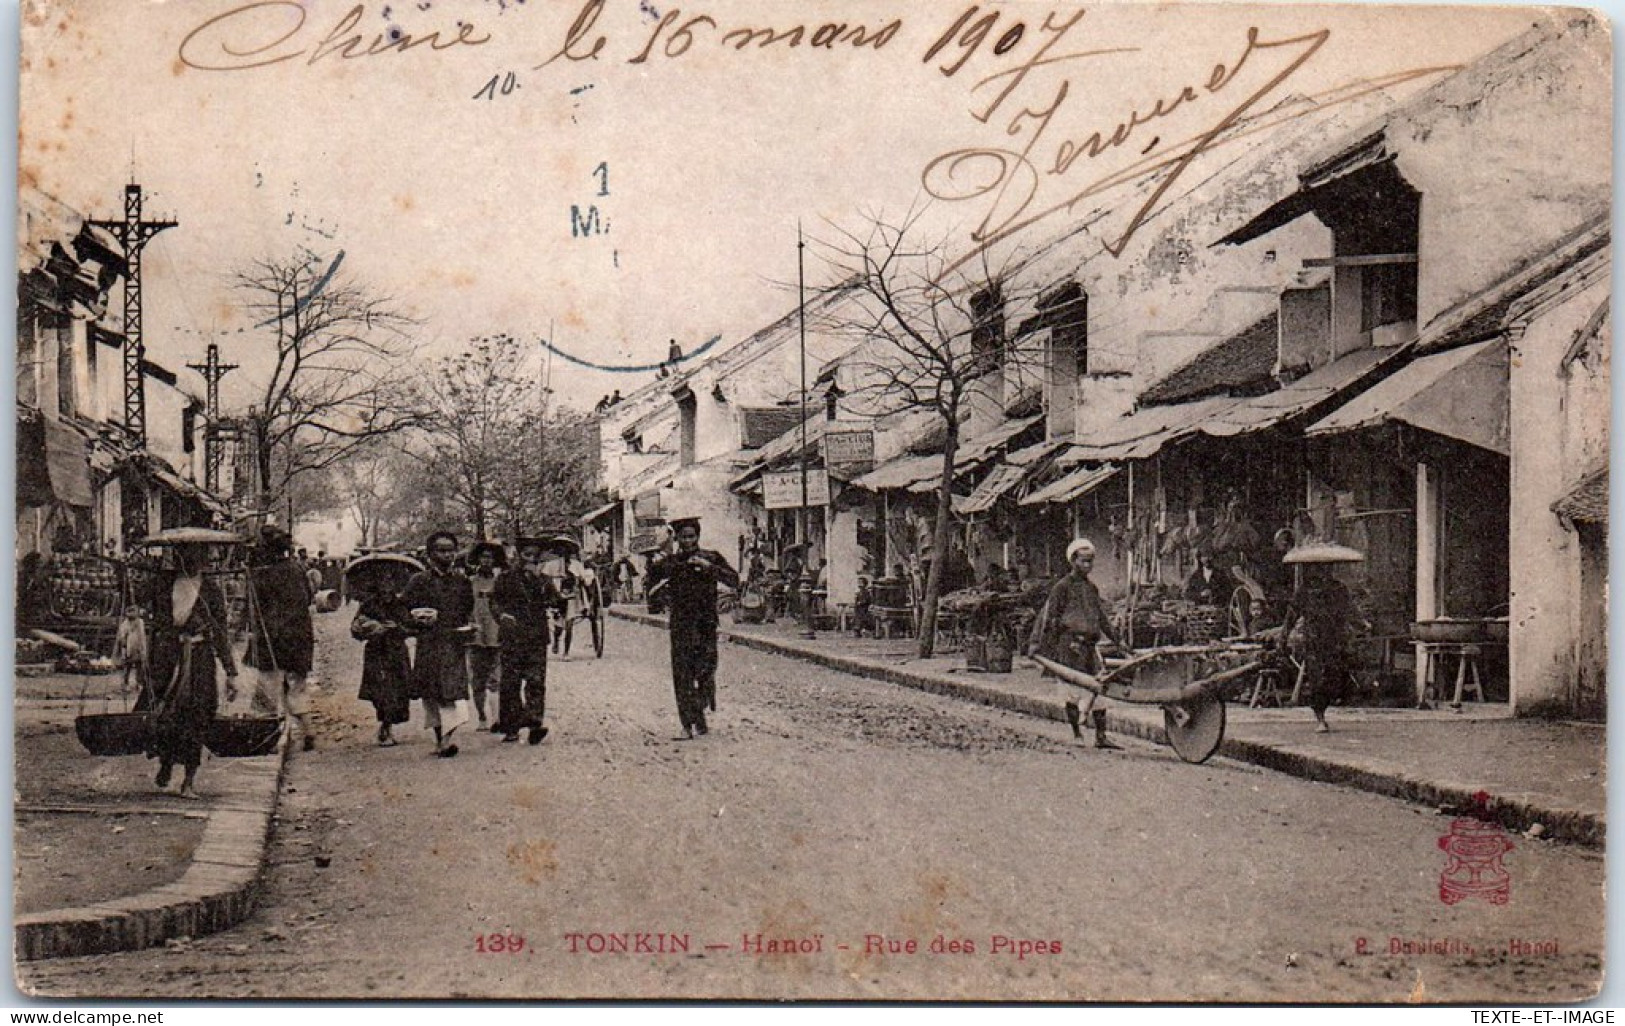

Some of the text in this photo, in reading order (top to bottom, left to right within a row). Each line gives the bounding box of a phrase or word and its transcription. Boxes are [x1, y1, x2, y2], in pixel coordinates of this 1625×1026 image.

[533, 0, 606, 71] le
[714, 18, 902, 49] mars
[923, 4, 1138, 124] 1907
